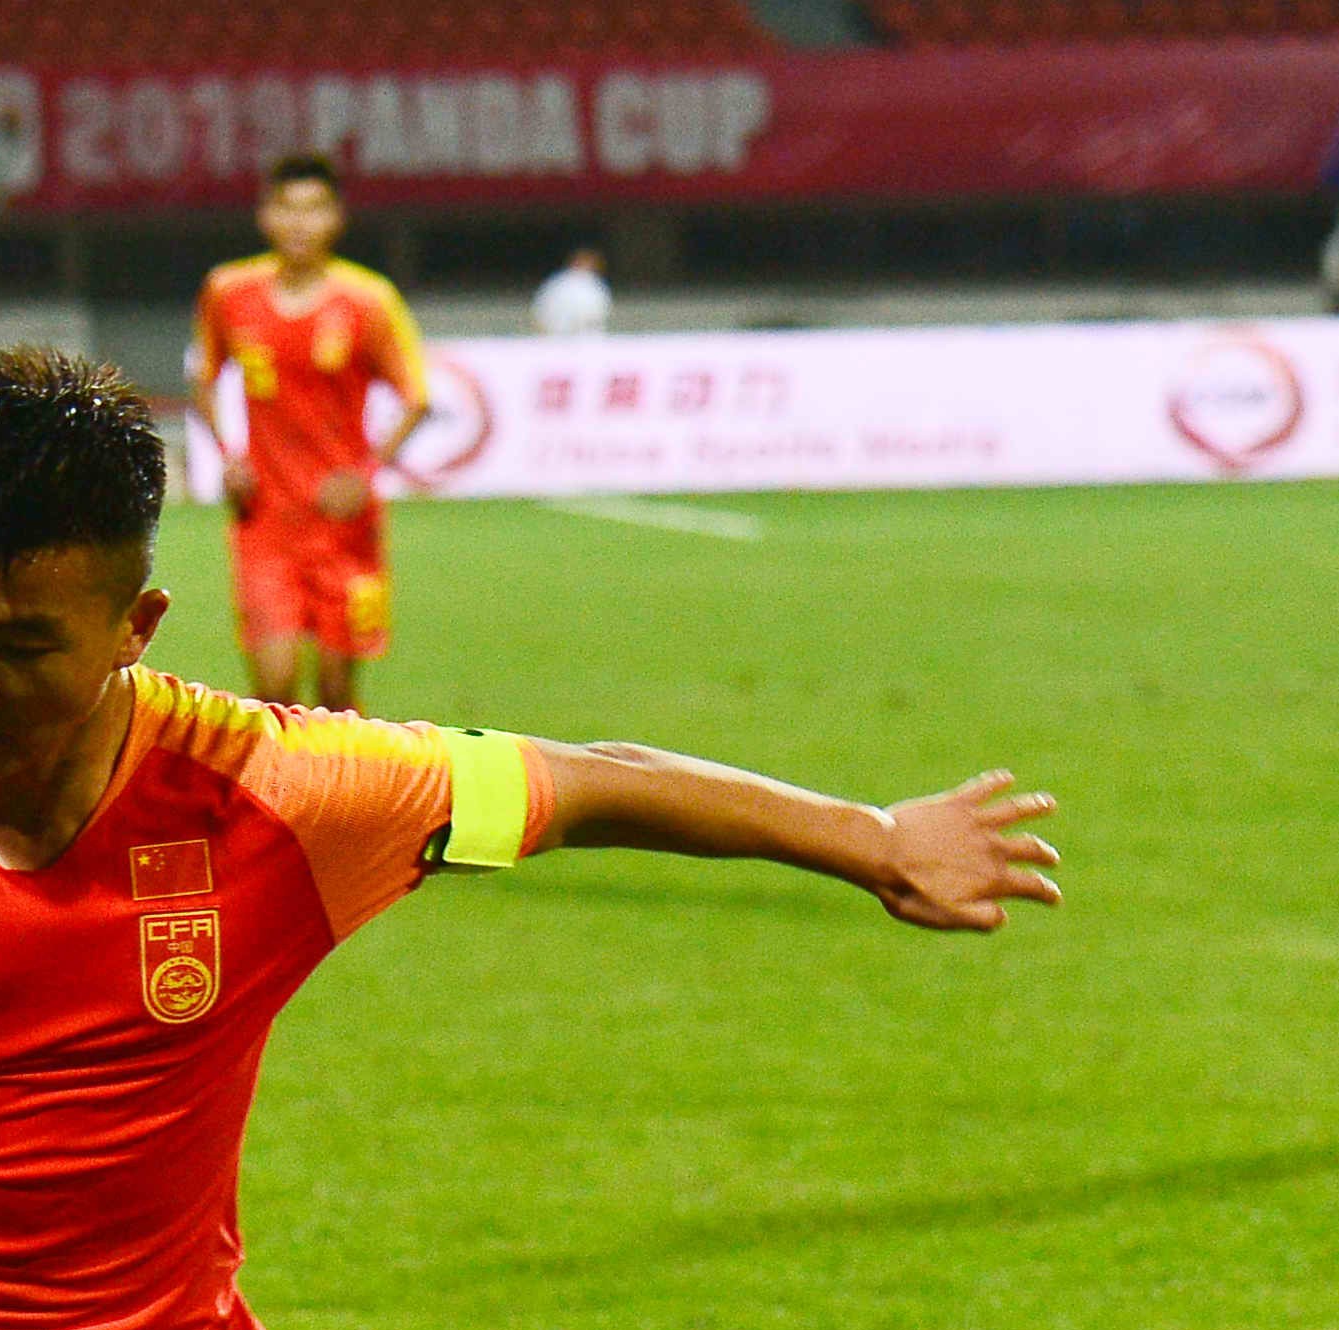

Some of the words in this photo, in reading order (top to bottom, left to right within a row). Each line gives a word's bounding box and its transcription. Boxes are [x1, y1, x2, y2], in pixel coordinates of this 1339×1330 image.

[57, 77, 298, 182] 2019
[310, 72, 584, 176] PANDA
[593, 70, 769, 173] CUP
[146, 918, 213, 942] CFA
